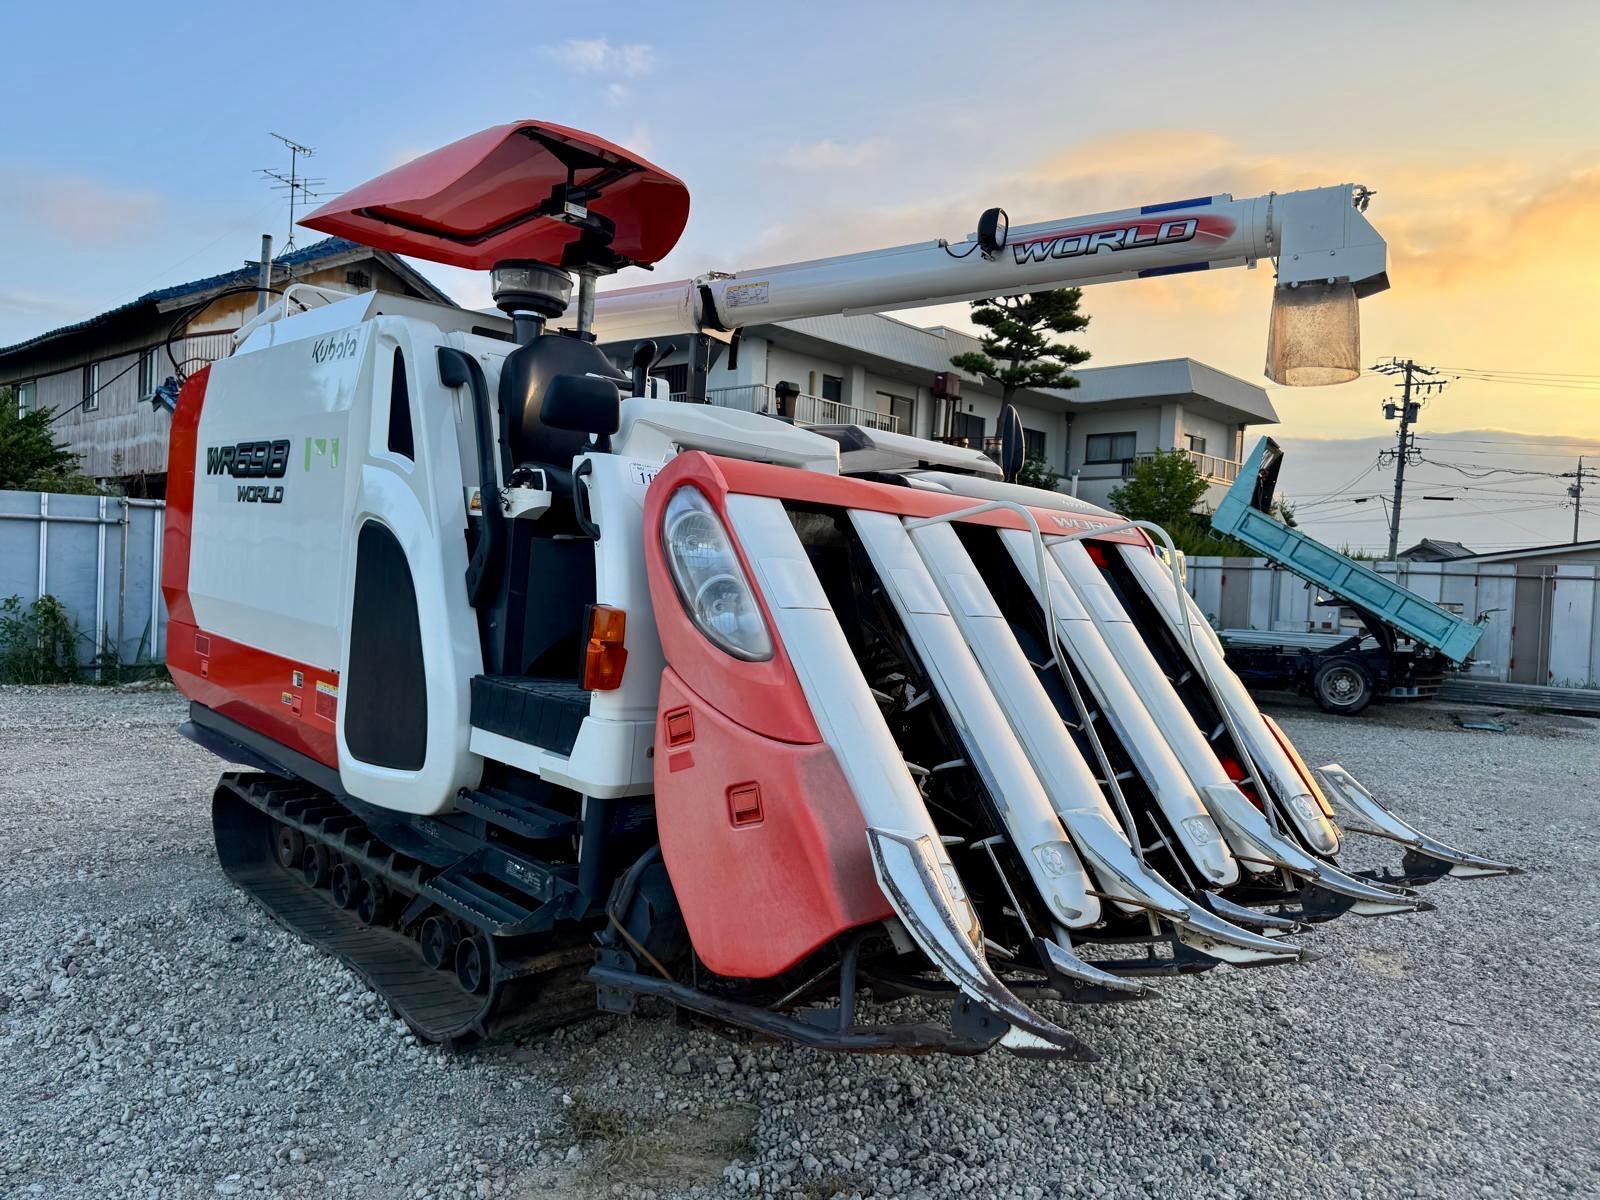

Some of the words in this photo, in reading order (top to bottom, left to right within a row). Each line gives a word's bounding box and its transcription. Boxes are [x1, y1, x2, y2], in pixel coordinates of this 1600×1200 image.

[1013, 218, 1199, 265] WORLD
[312, 333, 357, 363] Kubota
[207, 439, 290, 478] WR698
[237, 486, 284, 504] WORLD
